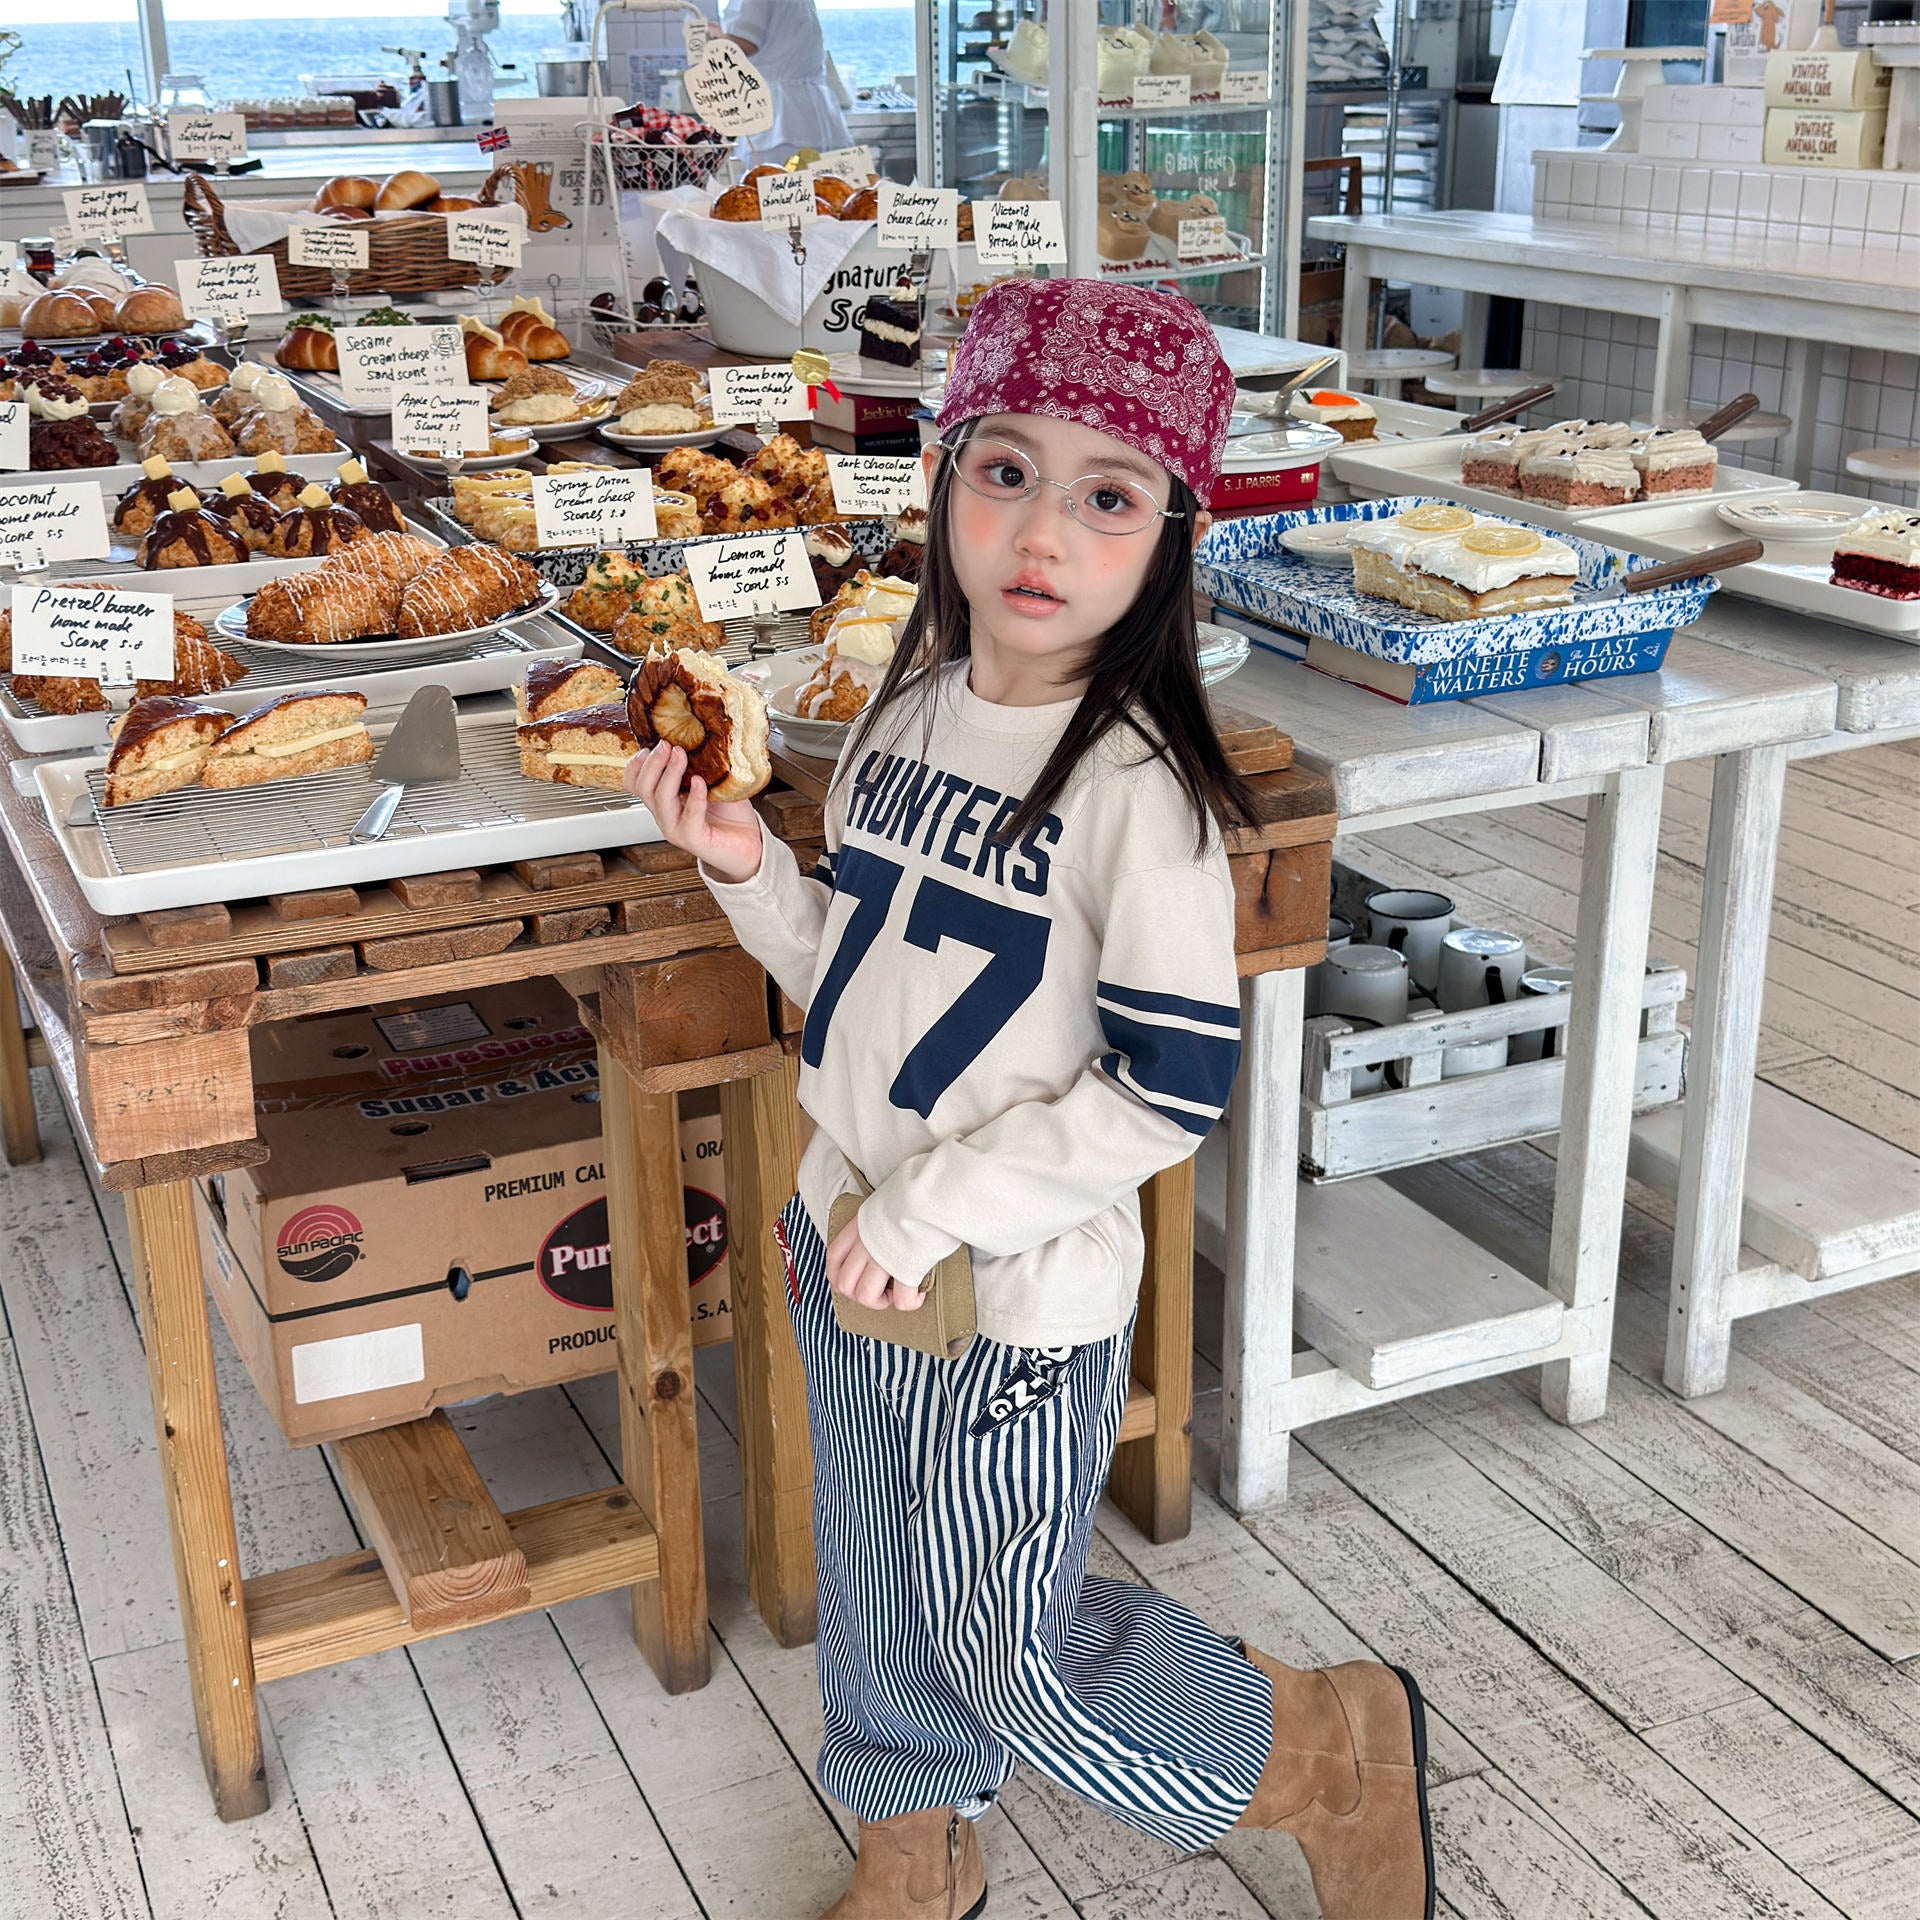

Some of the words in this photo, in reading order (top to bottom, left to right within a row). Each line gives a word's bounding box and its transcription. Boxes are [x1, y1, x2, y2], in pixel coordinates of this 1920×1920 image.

[1791, 63, 1829, 80] VINTAGE
[1794, 121, 1835, 138] VINTAGE
[892, 192, 939, 212] Blueberry
[346, 335, 393, 352] Sesame
[726, 367, 793, 387] Cranberry
[397, 393, 428, 407] Apple
[837, 458, 860, 468] dark
[546, 479, 592, 498] Spring
[1245, 474, 1281, 489] PARRIS
[718, 545, 766, 563] Lemon
[32, 589, 105, 613] Pretzel
[50, 614, 91, 629] home
[95, 616, 133, 633] made
[1589, 637, 1639, 658] LAST
[1435, 651, 1530, 680] MINETTE
[1562, 653, 1637, 678] HOURS
[1433, 668, 1527, 696] WALTERS
[846, 750, 1064, 898] HUNTERS
[801, 843, 1053, 1120] 77
[360, 1086, 490, 1119] Sugar
[497, 1080, 531, 1098] &
[534, 1061, 600, 1091] Aci
[485, 1170, 565, 1202] PREMIUM
